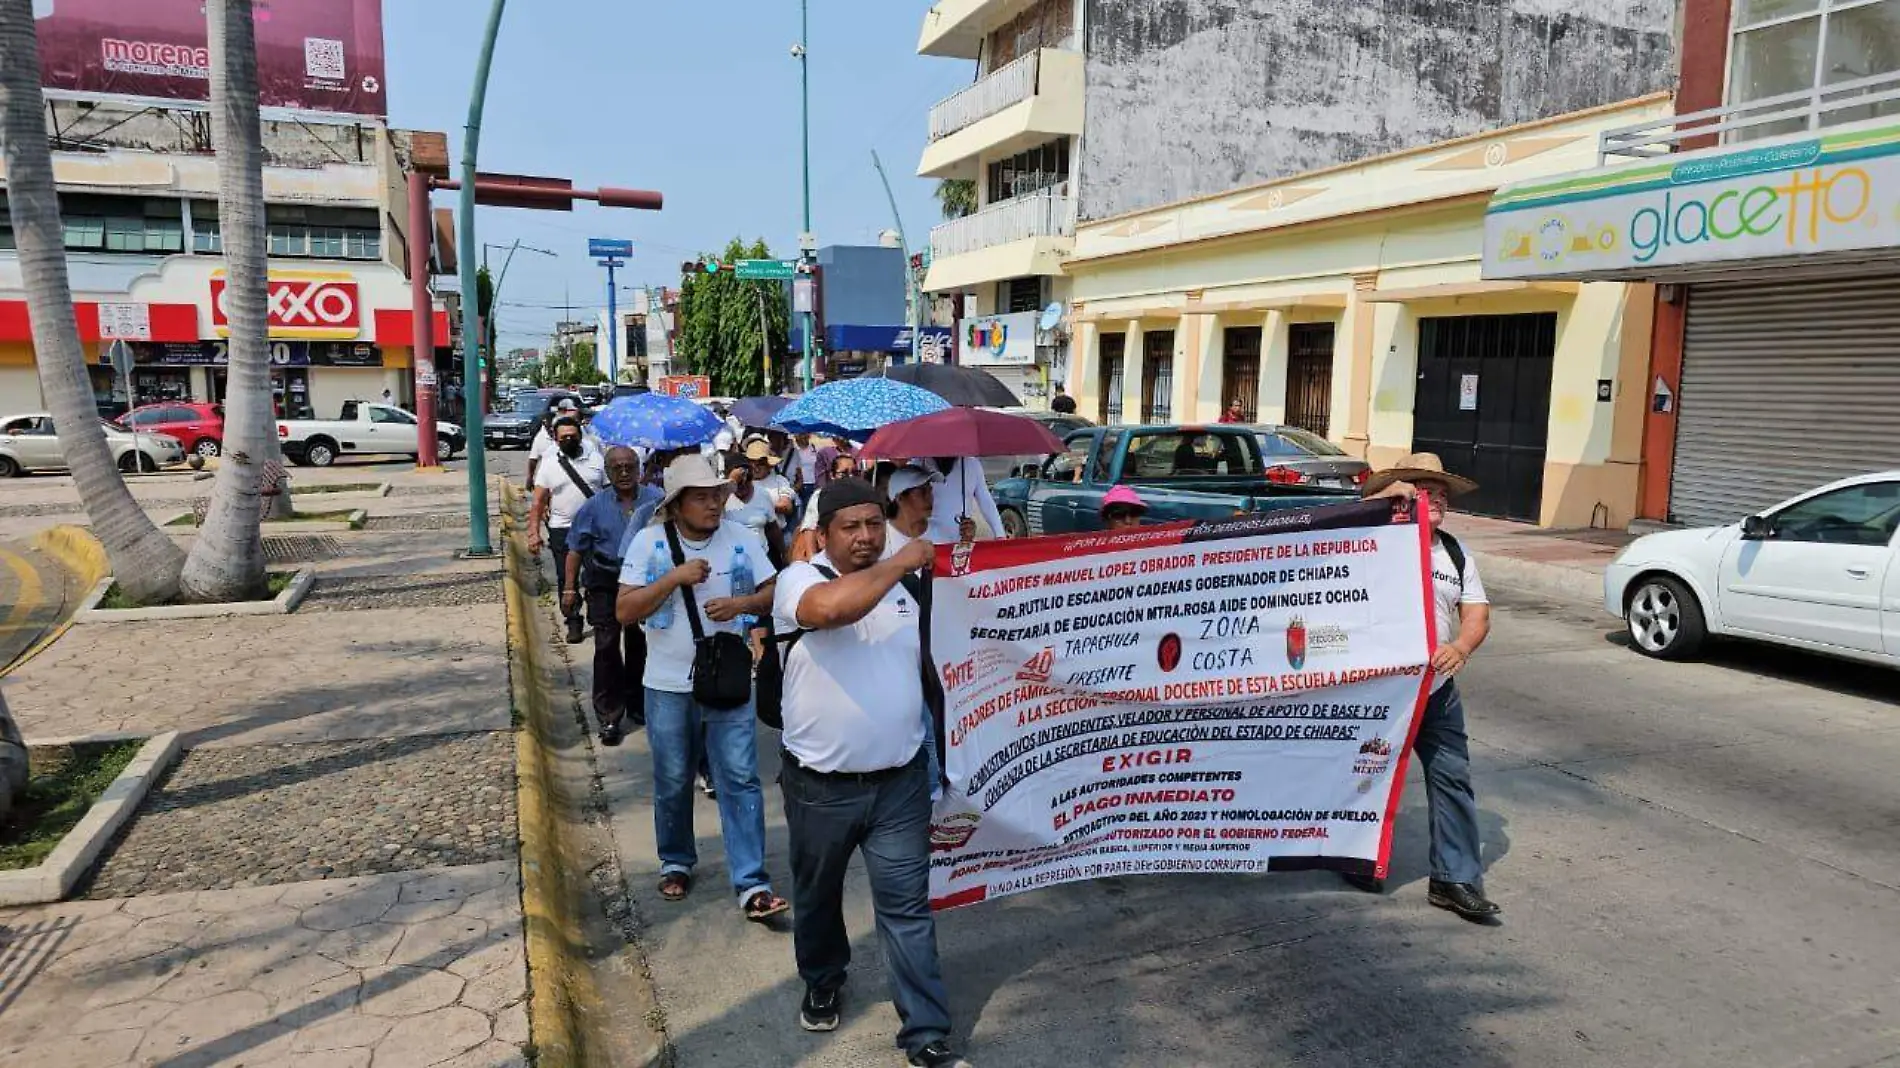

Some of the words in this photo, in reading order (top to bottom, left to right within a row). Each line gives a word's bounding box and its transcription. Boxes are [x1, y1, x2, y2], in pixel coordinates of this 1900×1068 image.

[102, 39, 209, 67] morena
[1630, 168, 1872, 264] glacetto
[217, 281, 353, 323] XXO
[918, 331, 952, 349] telc
[968, 573, 1040, 599] LIC.ANDRES
[1043, 568, 1095, 586] MANUEL
[1099, 561, 1136, 580] LOPEZ
[1140, 553, 1196, 573] OBRADOR
[1202, 546, 1274, 566] PRESIDENTE
[1277, 545, 1293, 559] DE
[1295, 543, 1310, 557] LA
[1312, 539, 1379, 555] REPUBLICA
[997, 595, 1064, 620] DR.RUTILIO
[1067, 583, 1134, 608] ESCANDON
[1136, 577, 1193, 598] CADENAS
[1195, 569, 1276, 590] GOBERNADOR
[1279, 568, 1295, 583] DE
[1298, 565, 1350, 582] CHIAPAS
[970, 620, 1050, 642] SECRETARIA
[1053, 617, 1070, 633] DE
[1072, 606, 1144, 631] EDUCACIÓN
[1146, 598, 1216, 620] MTRA.ROSA
[1219, 596, 1247, 612] AIDE
[1250, 592, 1322, 611] DOMINGUEZ
[1326, 588, 1369, 604] OCHOA
[1199, 615, 1260, 641] ZONA
[1065, 632, 1140, 658] TAPACHULA
[1192, 648, 1254, 671] COSTA
[1066, 664, 1137, 687] PRESENTE
[998, 691, 1012, 712] DE
[1163, 680, 1223, 700] DOCENTE
[1227, 678, 1243, 695] DE
[1247, 676, 1279, 694] ESTA
[1281, 671, 1337, 691] ESCUELA
[1017, 710, 1025, 728] A
[1028, 705, 1042, 722] LA
[1184, 705, 1245, 720] PERSONAL
[1250, 705, 1265, 718] DE
[1268, 704, 1309, 718] APOYO
[1312, 704, 1329, 717] DE
[1331, 704, 1361, 718] BASE
[1363, 705, 1373, 718] Y
[1373, 705, 1390, 719] DE
[1024, 756, 1039, 778] DE
[1039, 752, 1052, 770] LA
[1122, 730, 1138, 748] DE
[1140, 724, 1209, 745] EDUCACIÓN
[1211, 727, 1232, 741] DEL
[1235, 725, 1283, 741] ESTADO
[1285, 725, 1301, 740] DE
[1102, 748, 1193, 774] EXIGIR
[1051, 796, 1059, 809] A
[1059, 789, 1077, 805] LAS
[1078, 774, 1156, 797] AUTORIDADES
[1158, 770, 1242, 784] COMPETENTES
[1053, 811, 1071, 831] EL
[1073, 794, 1122, 820] PAGO
[1124, 787, 1236, 806] INMEDIATO
[1129, 811, 1150, 822] DEL
[1153, 807, 1178, 821] AÑO
[1180, 810, 1207, 821] 2023
[1210, 810, 1219, 821] Y
[1221, 808, 1313, 822] HOMOLOGACIÓN
[1315, 810, 1329, 821] DE
[1177, 828, 1200, 839] POR
[1204, 828, 1217, 839] EL
[1221, 828, 1279, 840] GOBIERNO
[1281, 827, 1329, 840] FEDERAL
[1209, 843, 1251, 851] SUPERIOR
[1022, 876, 1033, 887] LA
[1084, 864, 1101, 877] POR
[1104, 860, 1132, 872] PARTE
[1153, 859, 1202, 871] GOBIERNO
[1204, 858, 1256, 870] CORRUPTO
